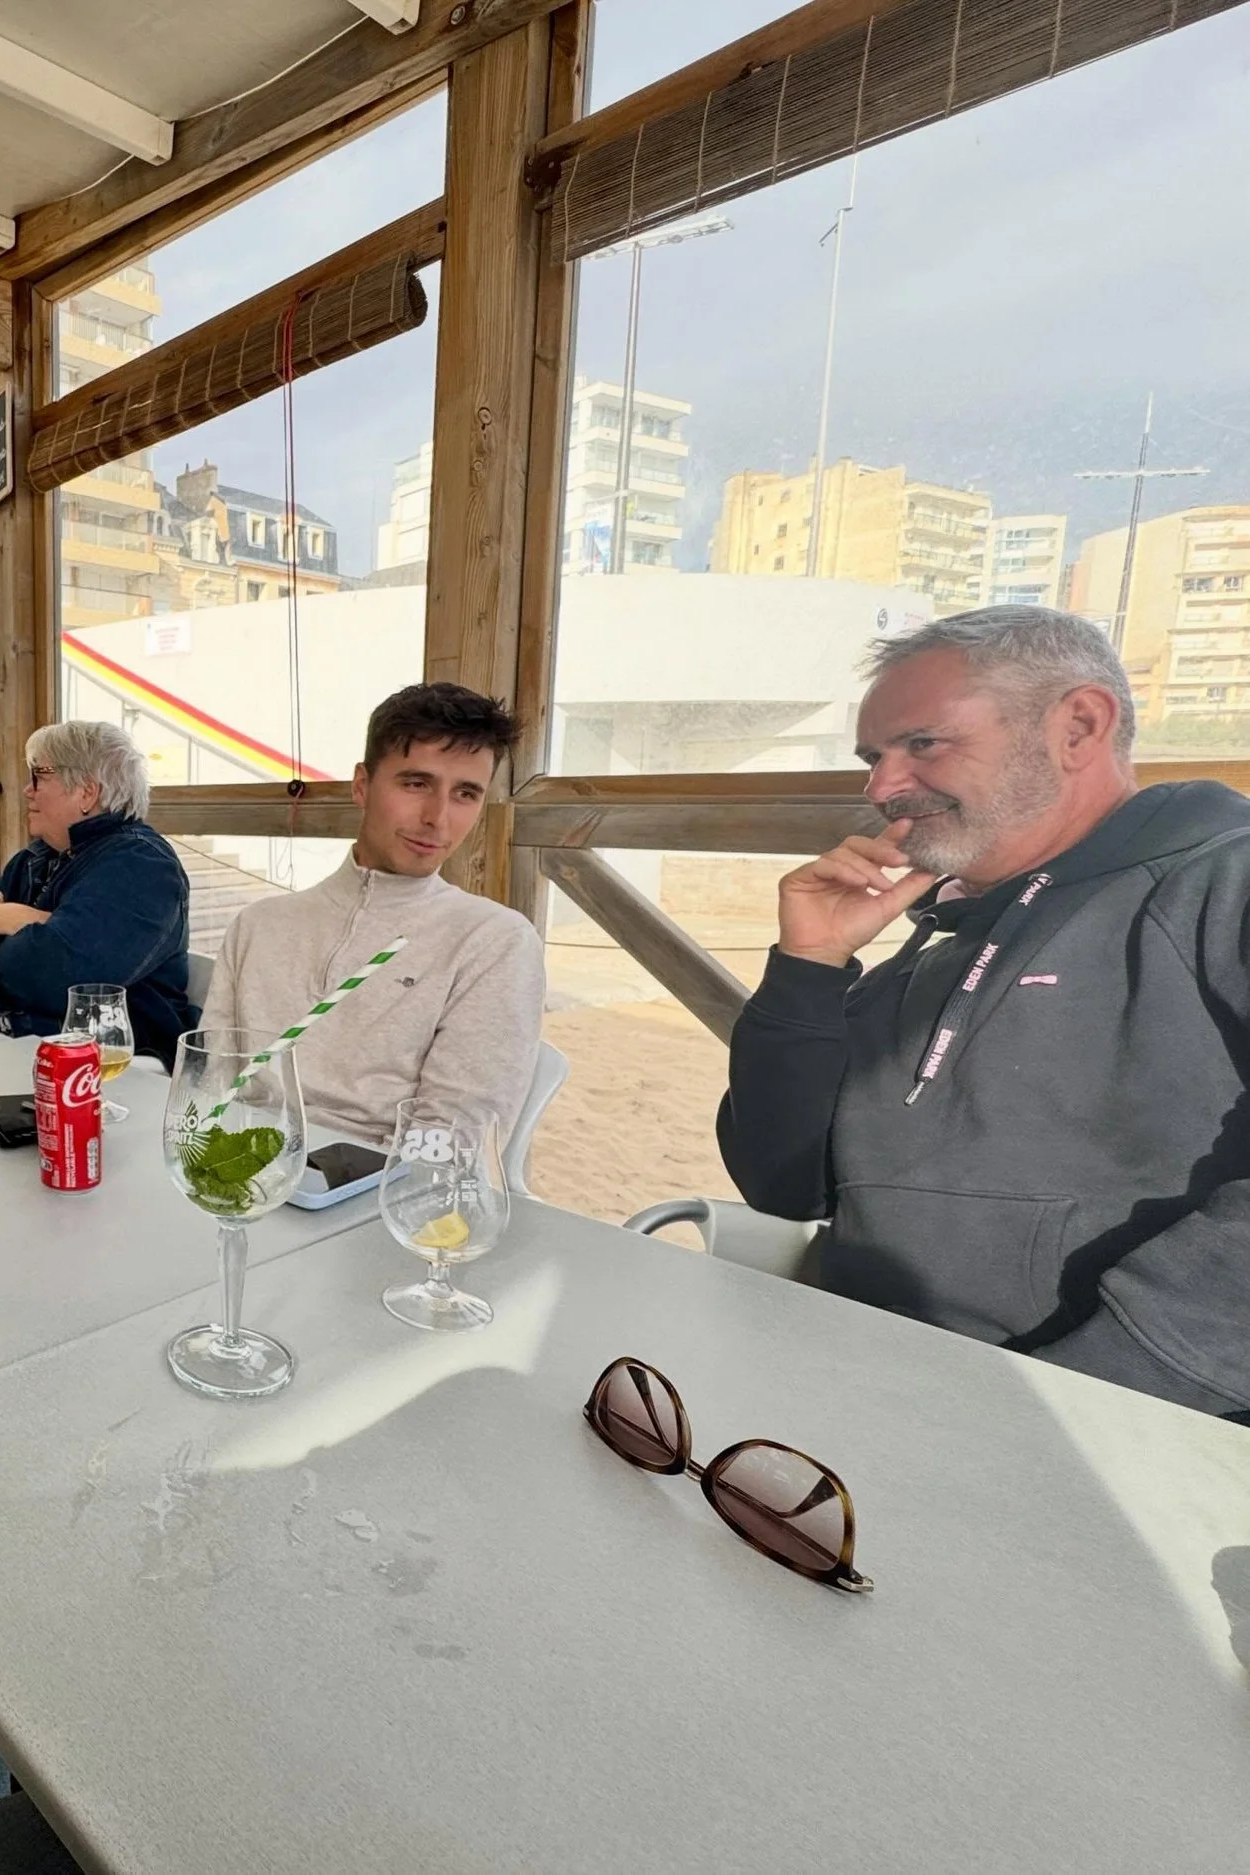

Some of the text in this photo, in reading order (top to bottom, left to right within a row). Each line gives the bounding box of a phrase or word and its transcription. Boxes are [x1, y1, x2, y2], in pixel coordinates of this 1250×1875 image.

[1018, 881, 1042, 906] PARK
[961, 942, 999, 992] EDEN PARK
